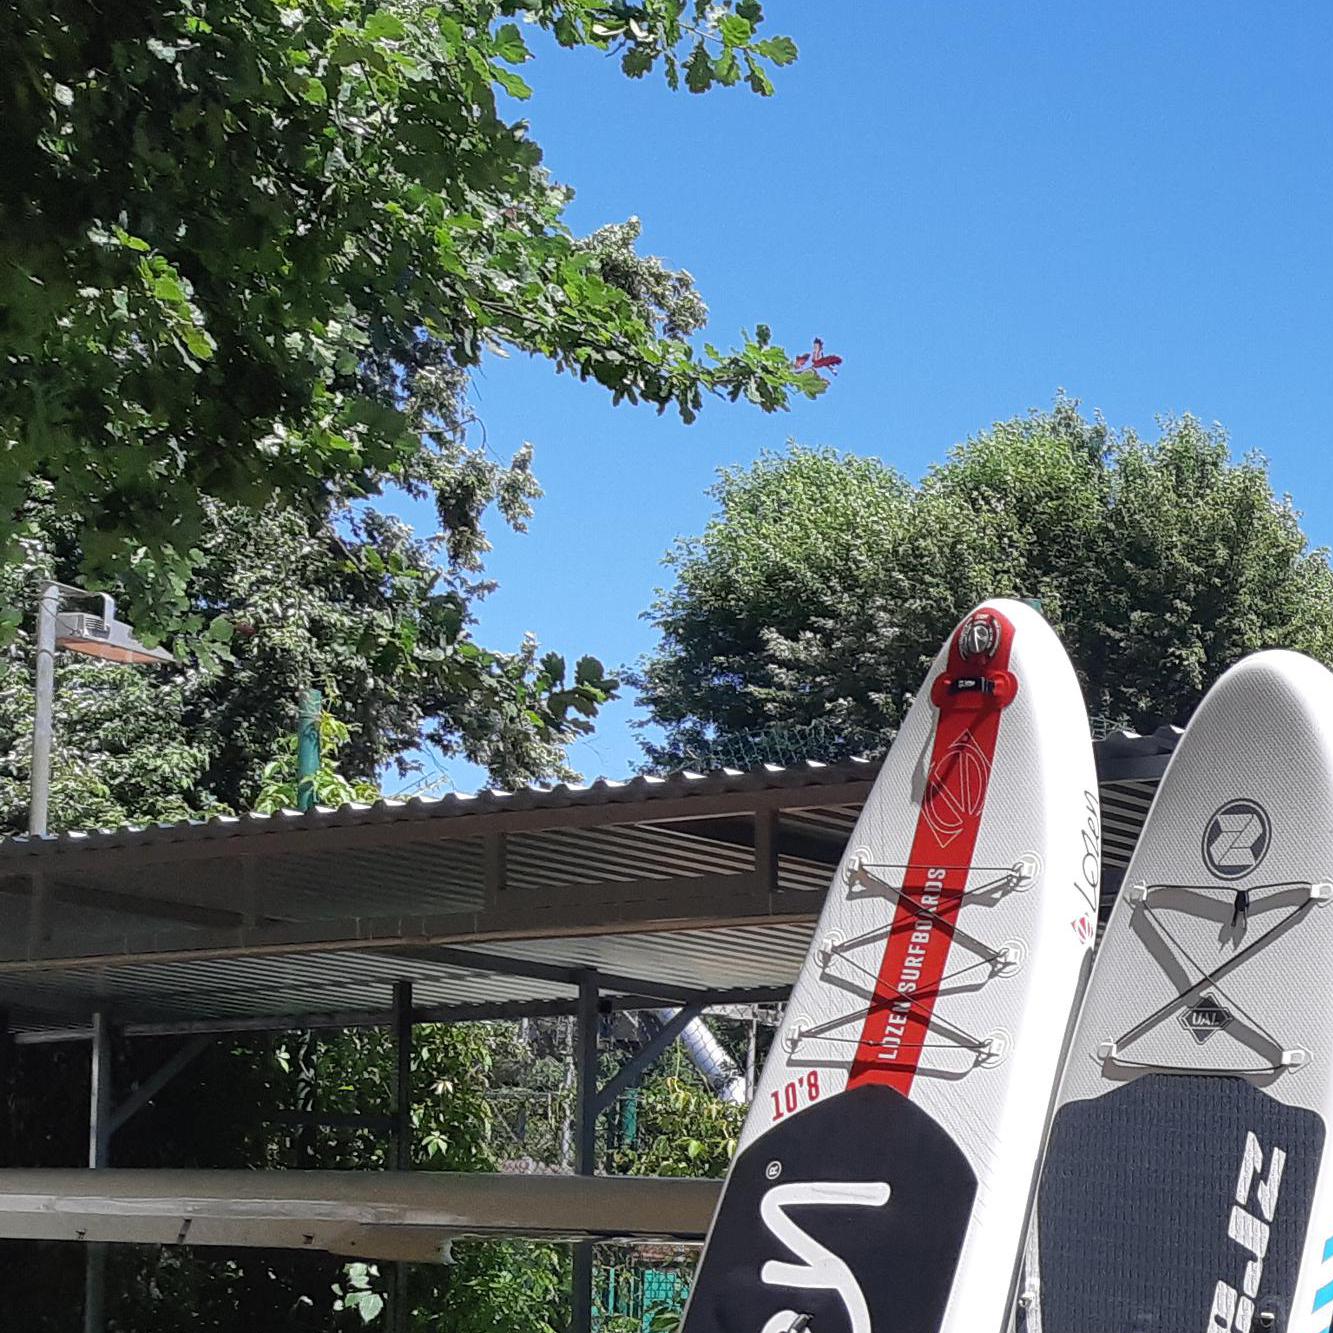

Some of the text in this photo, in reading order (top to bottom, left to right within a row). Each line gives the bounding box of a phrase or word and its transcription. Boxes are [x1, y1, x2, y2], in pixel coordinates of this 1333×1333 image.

[877, 867, 946, 1062] LOZEN SURFBOARDS
[770, 1070, 821, 1122] 10'8
